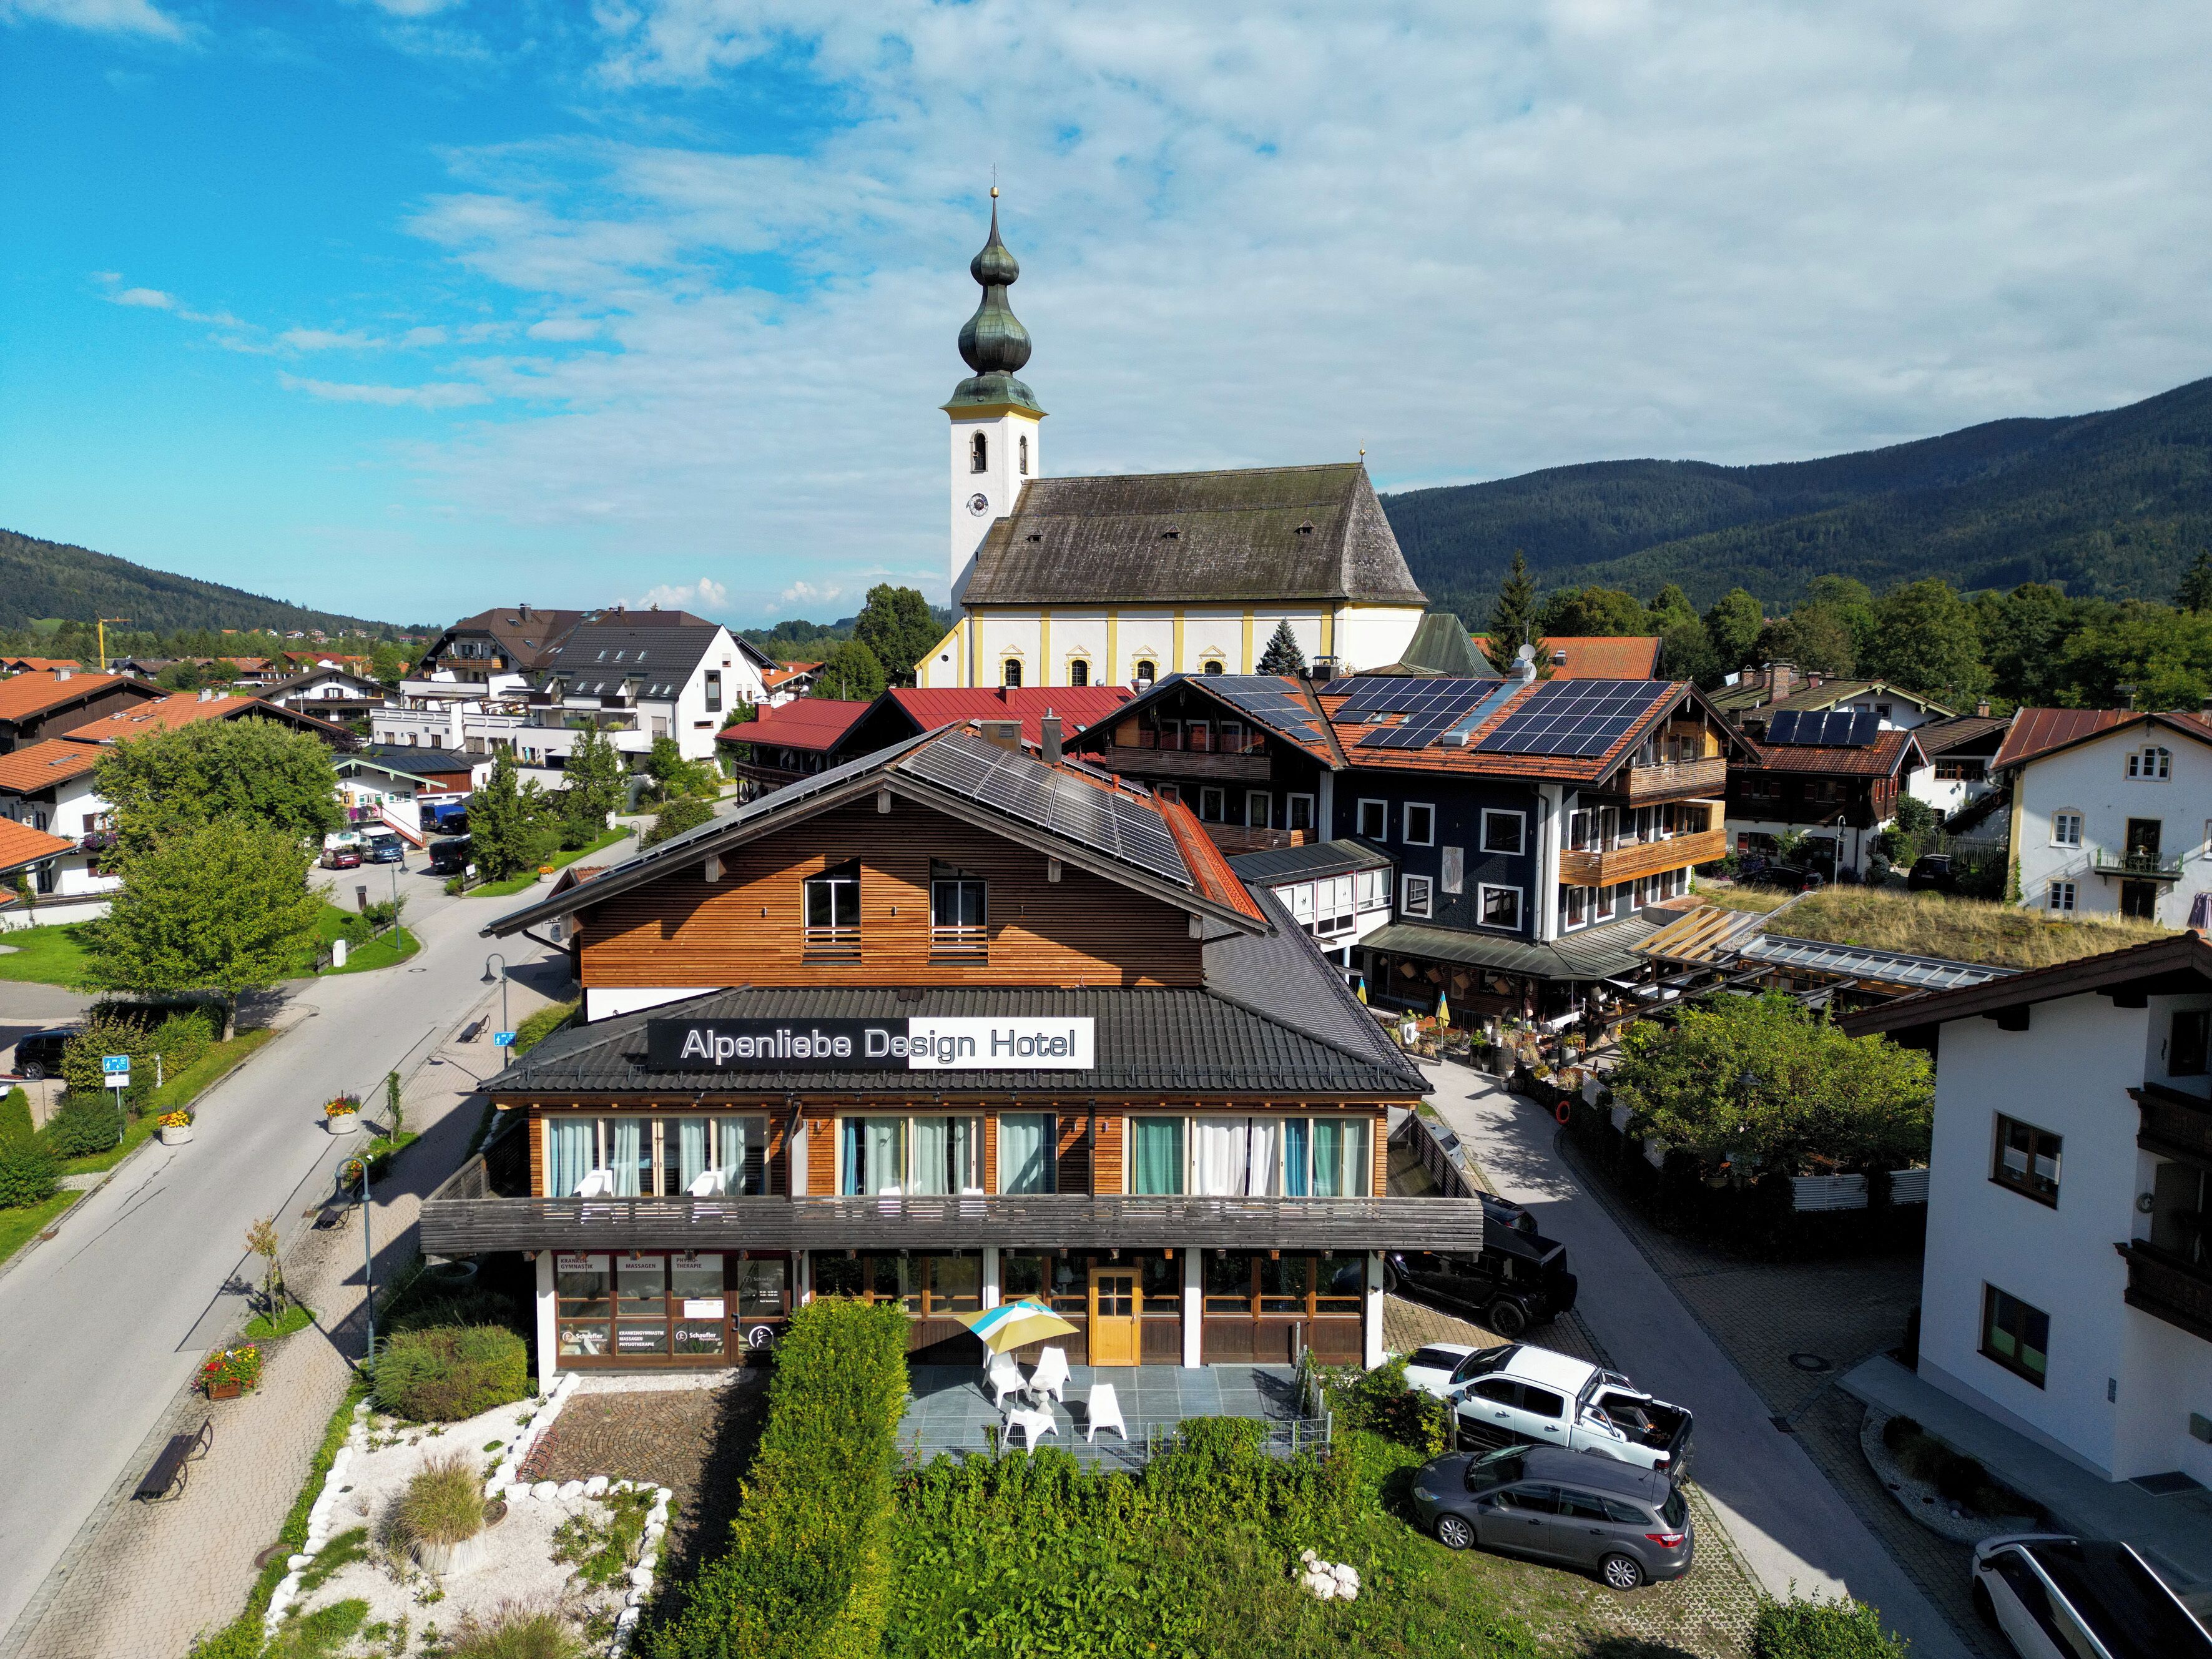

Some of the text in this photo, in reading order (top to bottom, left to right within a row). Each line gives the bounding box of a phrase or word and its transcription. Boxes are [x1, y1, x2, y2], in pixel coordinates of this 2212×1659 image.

[681, 1029, 1074, 1066] Alpenliebe Design Hotel
